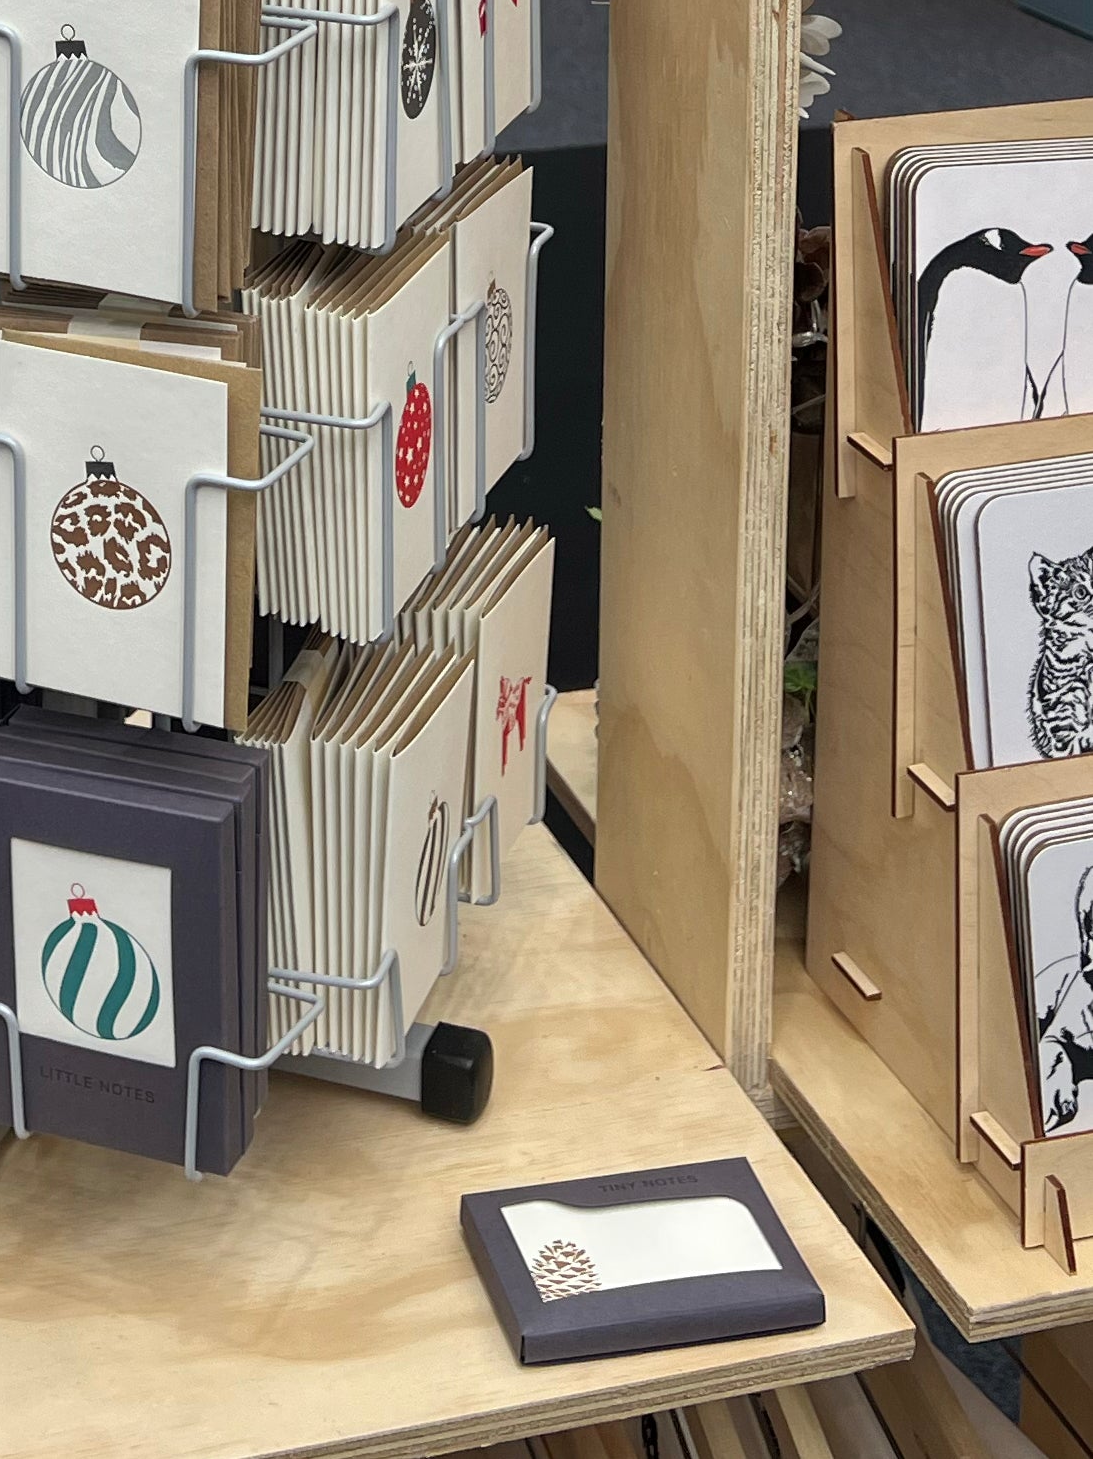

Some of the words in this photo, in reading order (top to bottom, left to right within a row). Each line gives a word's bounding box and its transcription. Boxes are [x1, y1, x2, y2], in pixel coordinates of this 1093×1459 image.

[40, 1065, 93, 1090] LITTLE
[100, 1080, 155, 1104] NOTES
[598, 1182, 635, 1192] TINY
[642, 1175, 698, 1187] NOTES
